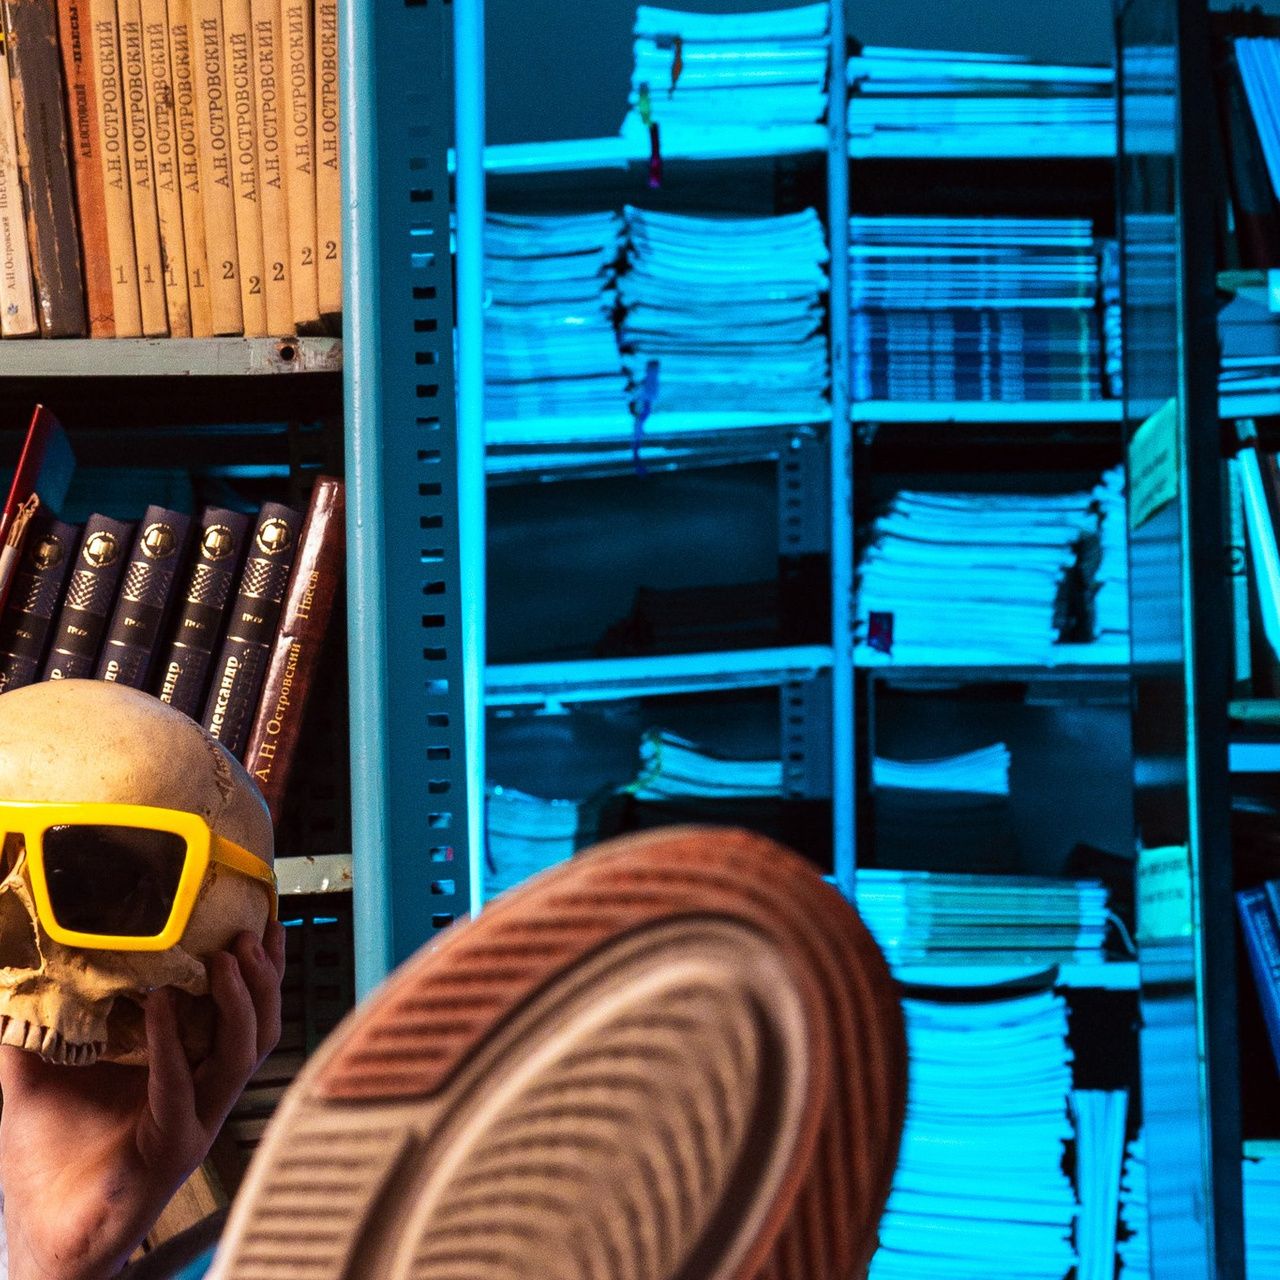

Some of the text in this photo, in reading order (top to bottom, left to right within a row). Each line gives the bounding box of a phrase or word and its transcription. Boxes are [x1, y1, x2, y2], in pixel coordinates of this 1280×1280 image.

[101, 20, 124, 191] А.Н.ОСТРОВСКИЙ
[127, 20, 150, 190] А.Н.ОСТРОВСКИЙ
[150, 22, 176, 192] А.Н.ОСТРОВСКИЙ
[173, 23, 200, 194] А.Н.ОСТРОВСКИЙ
[204, 17, 229, 189] А.Н.ОСТРОВСКИЙ
[230, 31, 257, 203] А.Н.ОСТРОВСКИЙ
[255, 19, 281, 190] А.Н.ОСТРОВСКИЙ
[286, 5, 311, 175] А.Н.ОСТРОВСКИЙ
[318, 3, 340, 171] А.Н.ОСТРОВСКИЙ
[116, 265, 129, 285] 1
[143, 264, 156, 284] 1
[166, 267, 179, 287] 1
[192, 268, 205, 288] 1
[222, 260, 235, 280] 2
[248, 275, 262, 295] 2
[272, 262, 285, 282] 2
[301, 246, 314, 266] 2
[325, 240, 338, 260] 2
[207, 655, 244, 741] лександр
[253, 567, 320, 783] А. Н. Островский Пьесы
